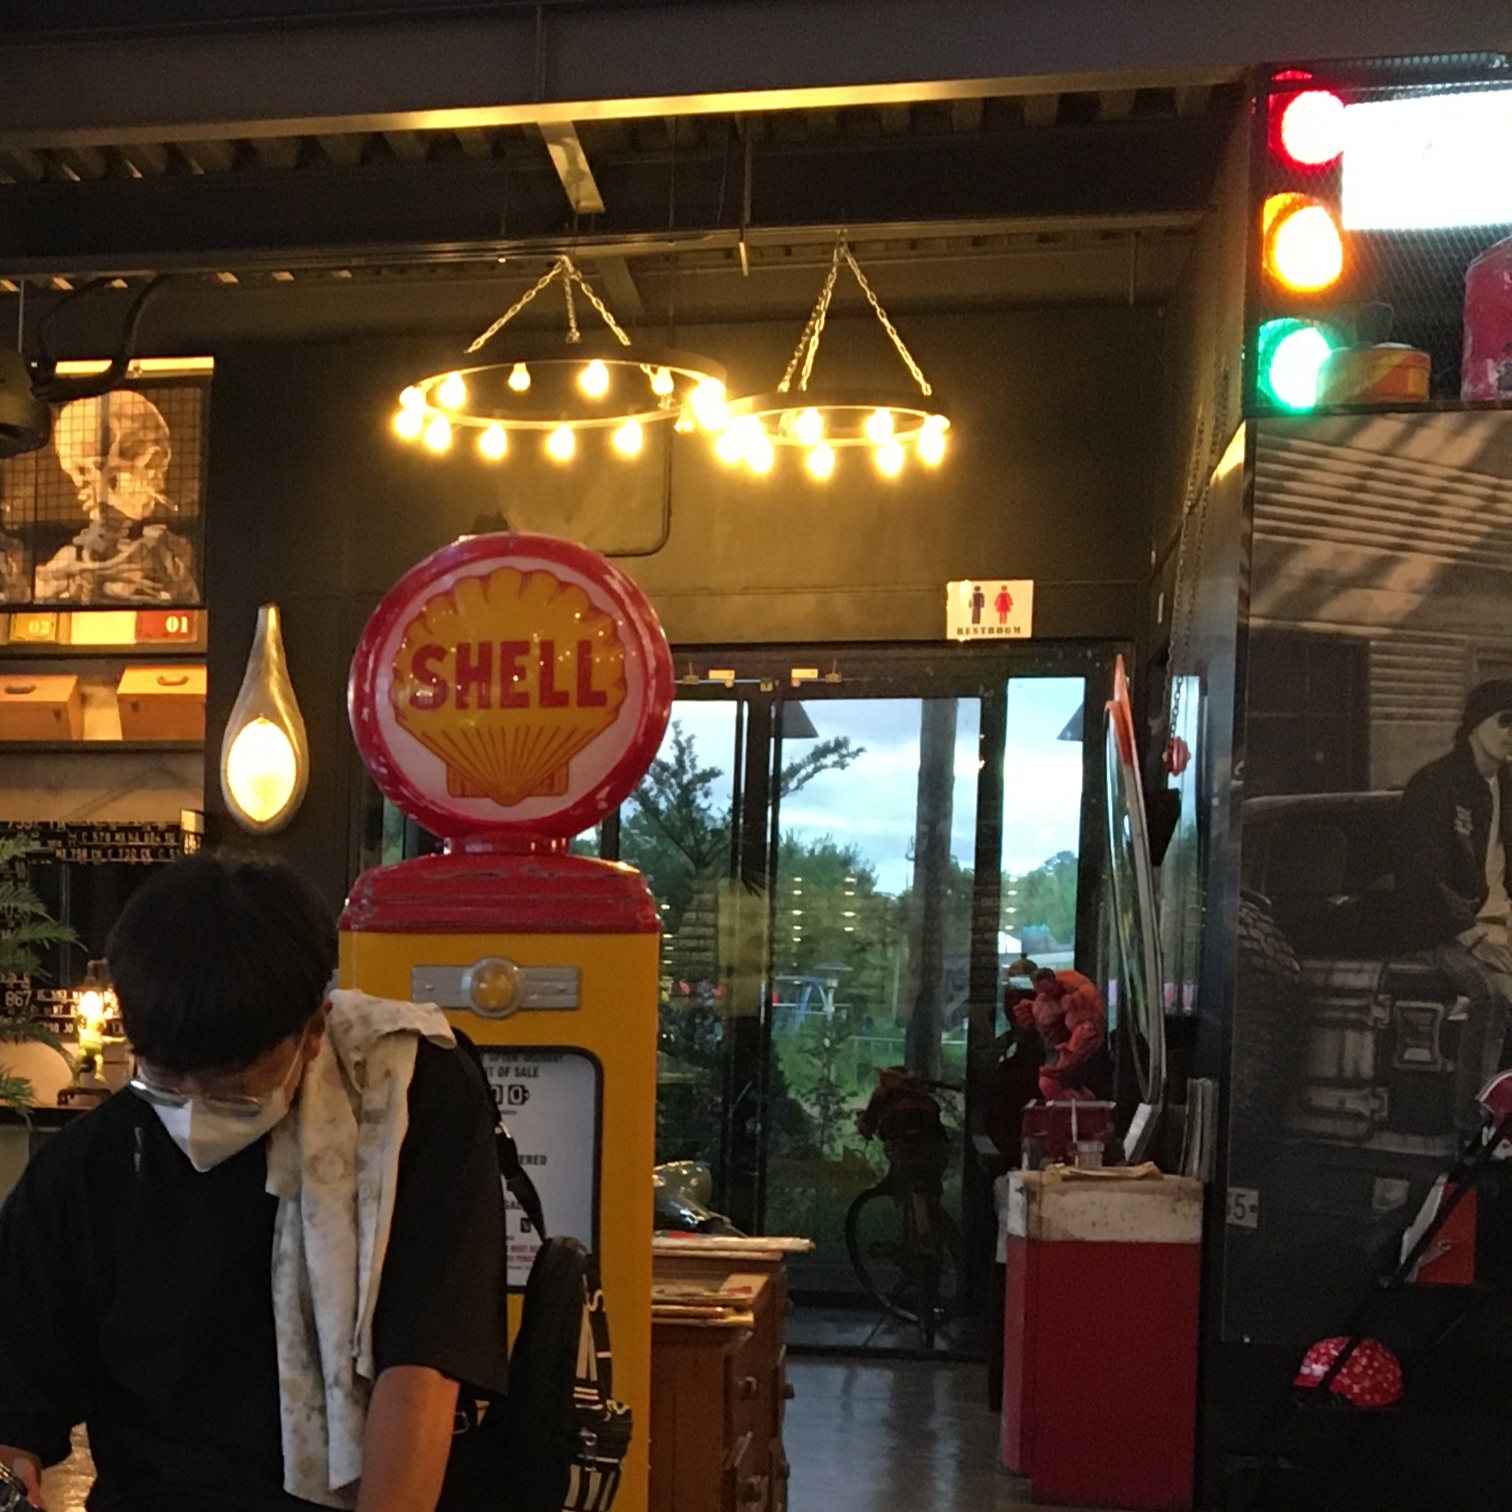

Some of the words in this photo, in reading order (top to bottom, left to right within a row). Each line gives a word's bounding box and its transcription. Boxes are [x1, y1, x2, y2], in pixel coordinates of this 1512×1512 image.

[28, 619, 51, 634] 02
[166, 616, 188, 633] 01
[957, 626, 1021, 635] RESTROOM
[409, 639, 607, 711] SHELL
[4, 990, 32, 1007] 867
[497, 1066, 510, 1078] OF
[514, 1066, 540, 1079] SALE
